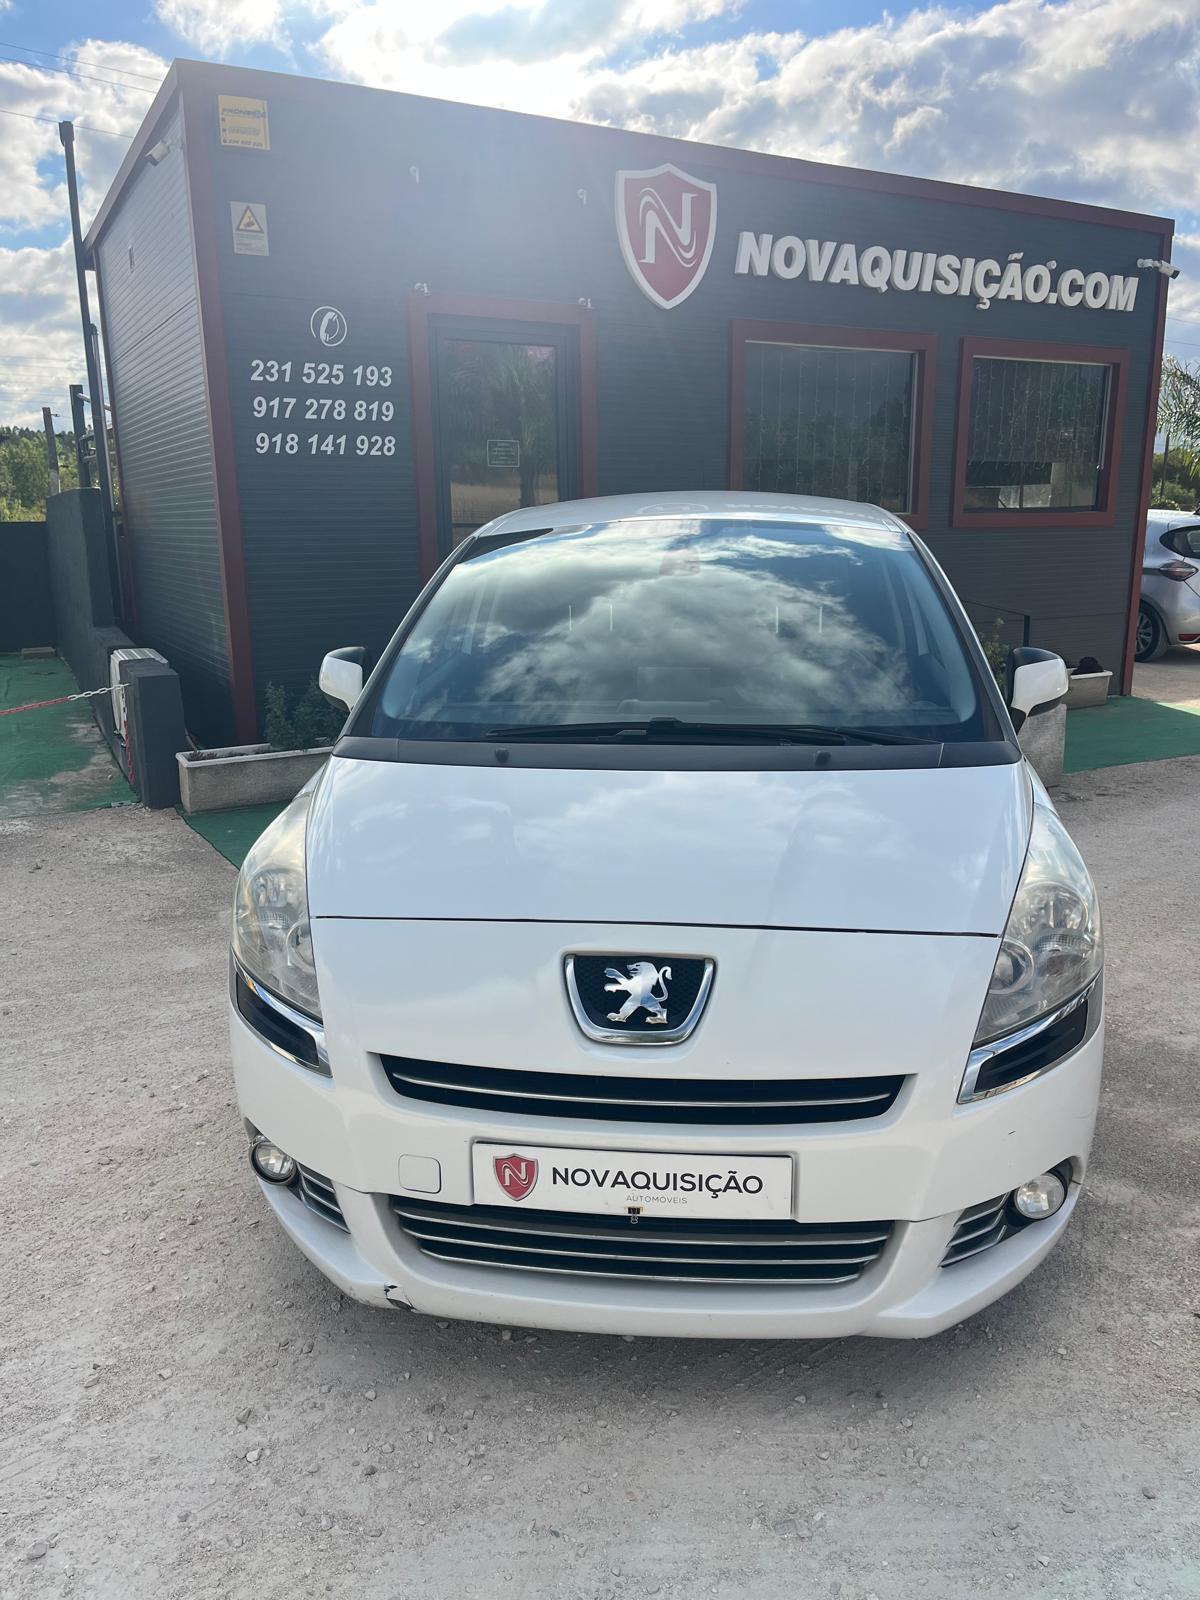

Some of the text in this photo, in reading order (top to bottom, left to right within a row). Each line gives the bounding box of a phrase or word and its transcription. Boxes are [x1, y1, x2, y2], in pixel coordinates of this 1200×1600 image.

[734, 231, 1139, 311] NOVAQUISIÇÃO.COM
[250, 359, 392, 387] 231 525 193
[253, 396, 394, 422] 917 278 819
[255, 432, 396, 456] 918 141 928
[552, 1166, 763, 1198] NOVAQUISIÇÃO
